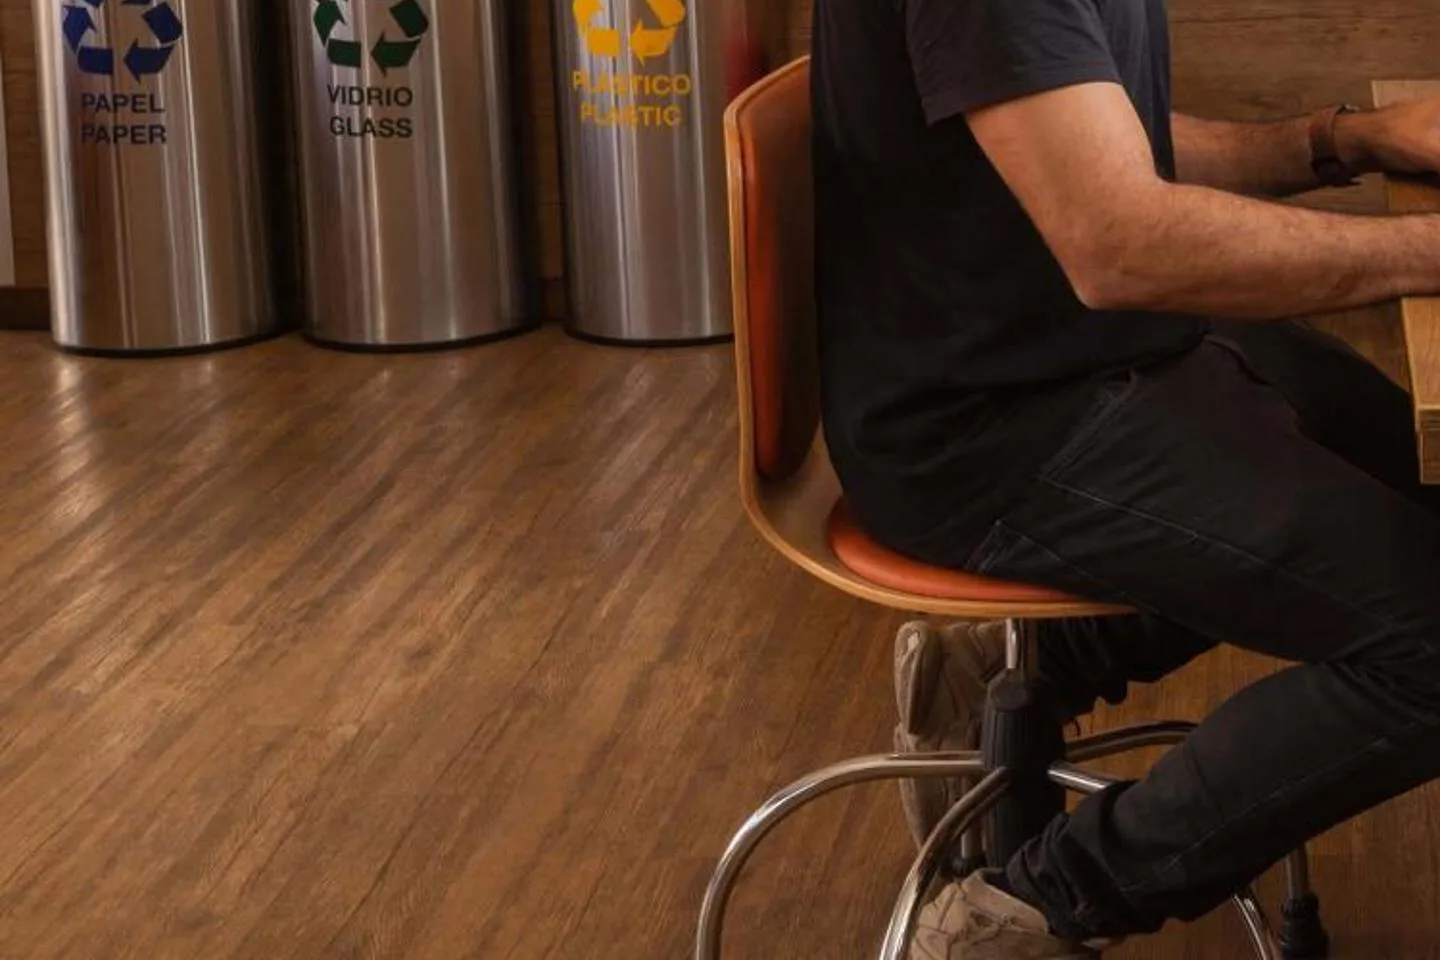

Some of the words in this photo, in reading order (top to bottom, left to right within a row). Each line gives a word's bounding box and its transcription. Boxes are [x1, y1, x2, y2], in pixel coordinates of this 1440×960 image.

[573, 70, 691, 96] PLASTICO
[81, 93, 166, 114] PAPEL
[327, 84, 413, 107] VIDRIO
[581, 101, 682, 127] PLASTIC
[81, 124, 167, 145] PAPER
[329, 116, 413, 138] GLASS
